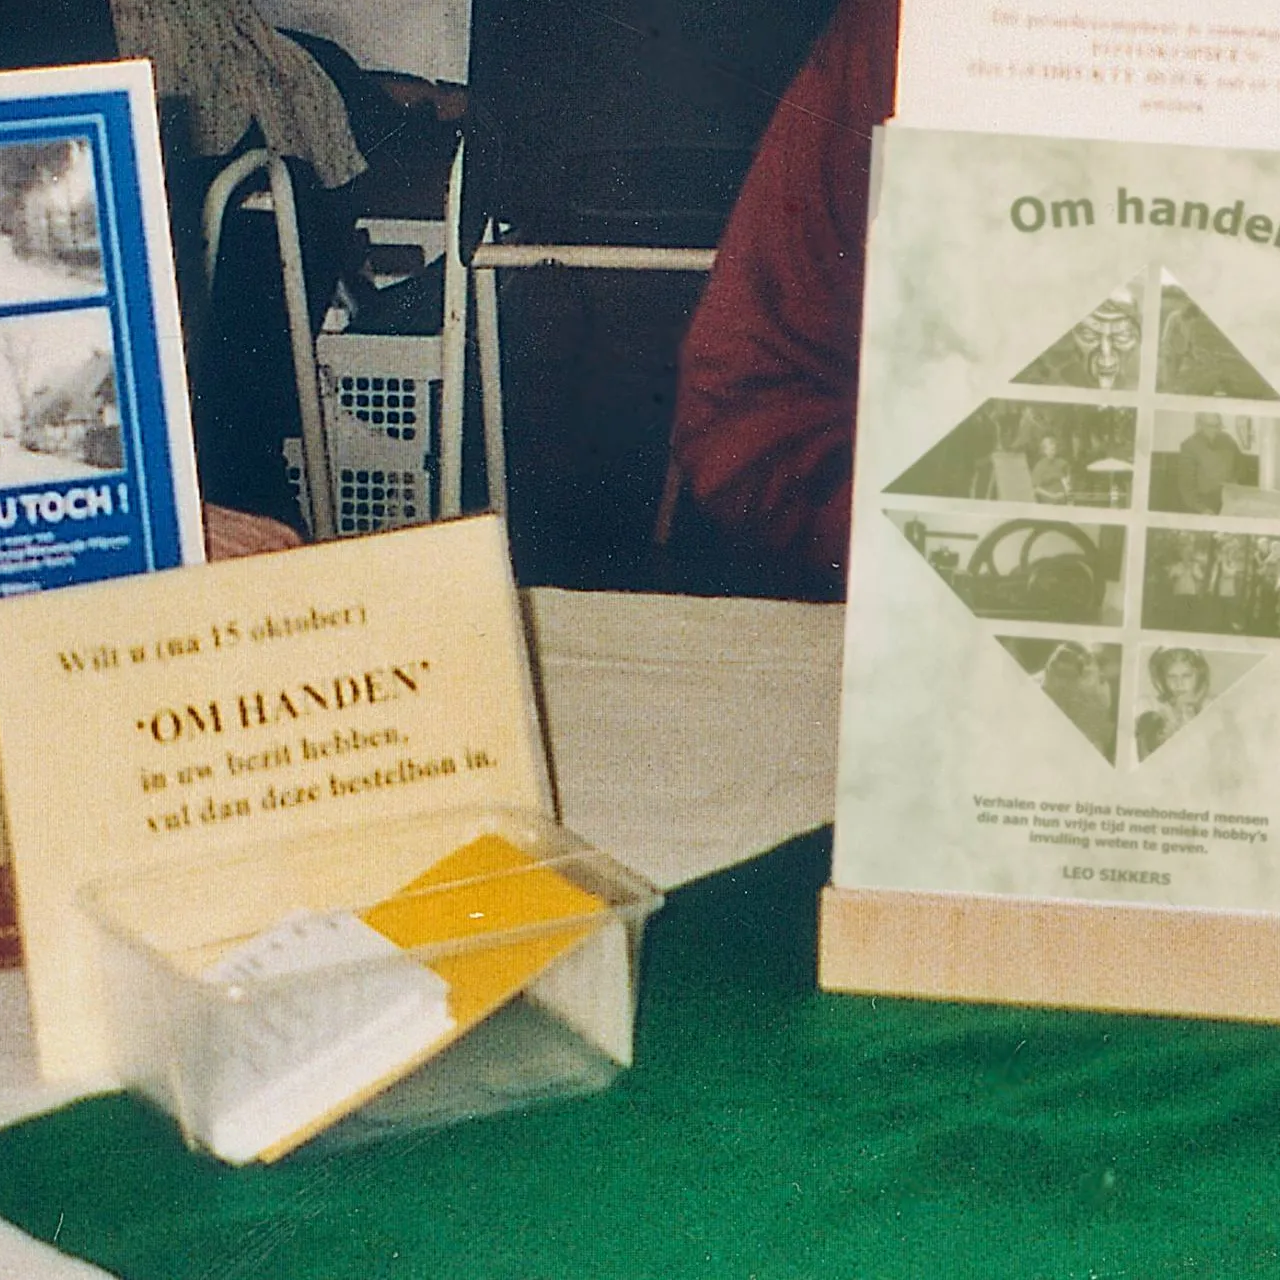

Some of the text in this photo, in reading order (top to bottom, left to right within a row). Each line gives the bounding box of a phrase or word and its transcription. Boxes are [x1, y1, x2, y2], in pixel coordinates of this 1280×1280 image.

[1010, 194, 1096, 234] Om
[129, 646, 146, 664] u
[211, 620, 242, 650] 15
[140, 766, 168, 794] in
[176, 765, 213, 785] uw
[147, 801, 192, 832] vul
[200, 795, 252, 825] dan
[261, 783, 322, 813] deze
[327, 757, 457, 798] bestelbon
[973, 793, 1270, 827] Verhalen over bijna tweehonderd mensen
[976, 811, 1269, 844] die aan hun vrije tijd met unieke hobby's
[1028, 830, 1210, 855] invulling weten te geven.
[1061, 865, 1173, 886] LEO SIKKERS
